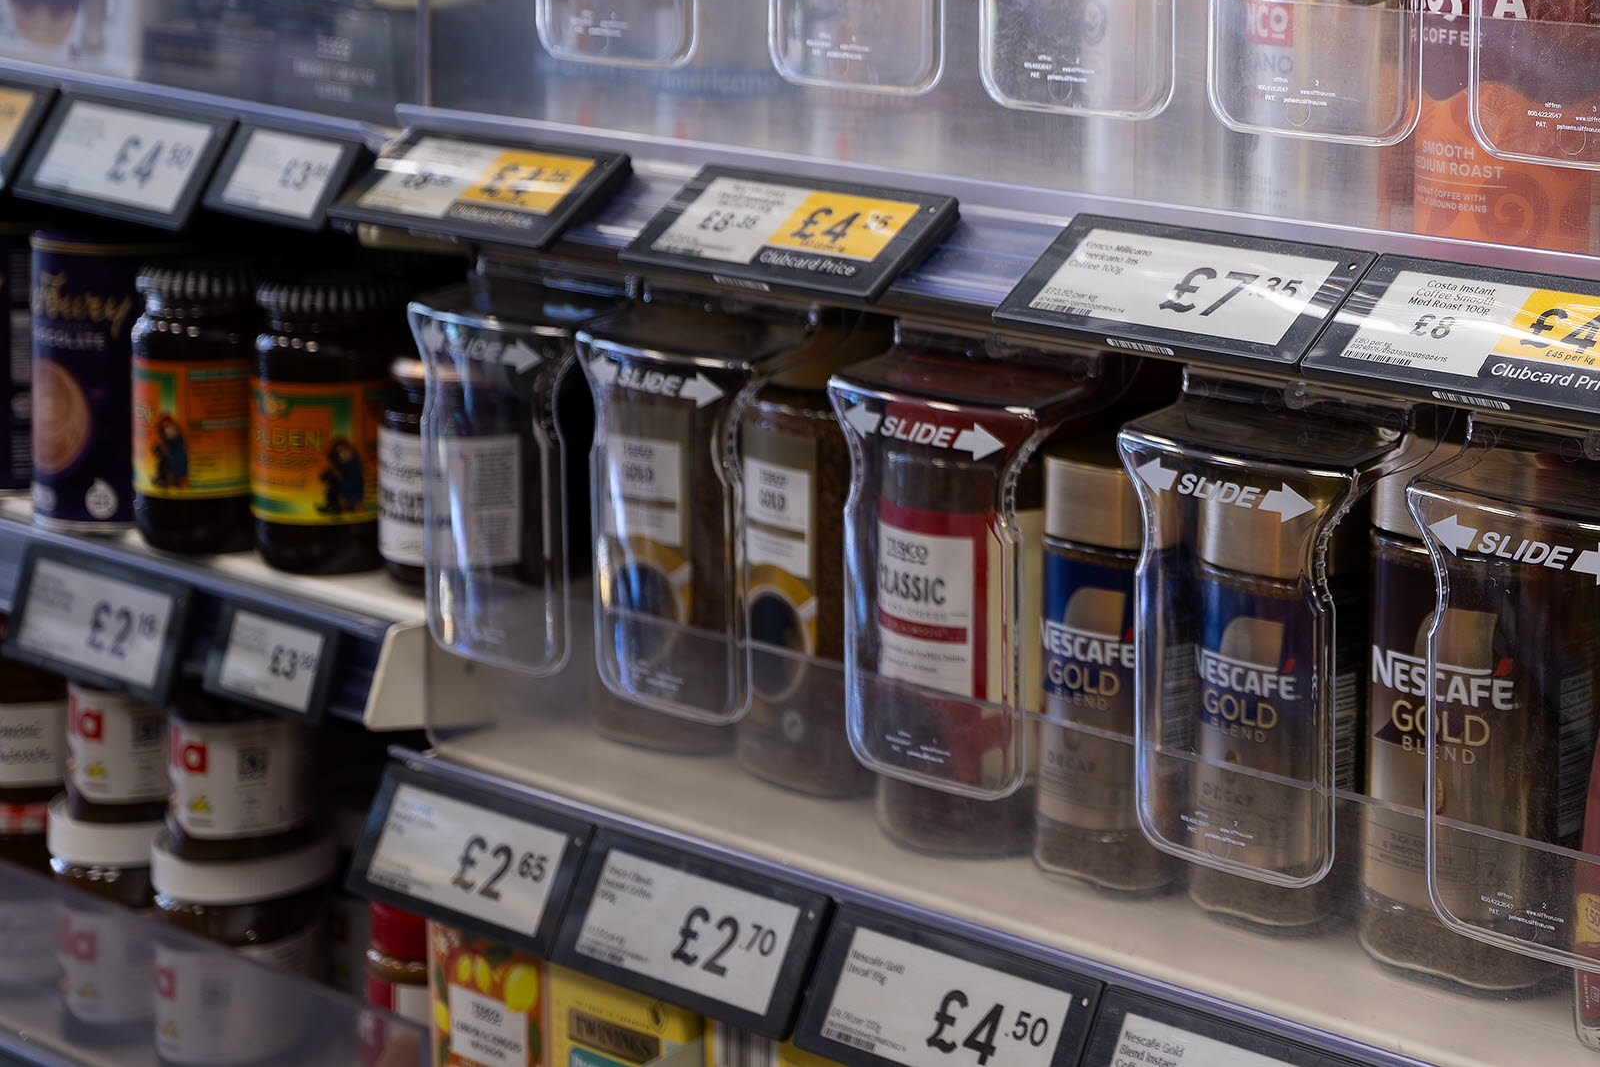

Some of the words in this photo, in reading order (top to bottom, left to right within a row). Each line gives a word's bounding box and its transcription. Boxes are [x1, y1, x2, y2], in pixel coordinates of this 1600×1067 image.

[760, 250, 817, 273] Clubcard
[819, 259, 856, 277] Price
[1086, 240, 1112, 254] Kenco
[1114, 244, 1152, 258] Millicano
[1068, 260, 1099, 273] Coffee
[1101, 264, 1123, 275] 100g
[1159, 266, 1303, 317] £7.35
[1416, 287, 1455, 300] Coffee
[1456, 292, 1495, 306] Smooth
[1427, 279, 1459, 292] Costa
[1460, 283, 1496, 296] Instant
[1407, 296, 1430, 308] Med
[1432, 299, 1463, 311] Roast
[1465, 304, 1491, 317] 100g
[1409, 313, 1456, 339] £8
[1545, 350, 1561, 359] £45
[1562, 353, 1582, 363] per
[1584, 356, 1595, 365] kg
[617, 367, 683, 396] SLIDE
[1491, 362, 1573, 388] Clubcard
[881, 415, 956, 448] SLIDE
[1177, 473, 1261, 509] SLIDE
[1476, 531, 1574, 571] SLIDE
[879, 563, 946, 606] CLASSIC
[1047, 655, 1121, 697] GOLD
[1203, 688, 1278, 730] GOLD
[1391, 699, 1490, 748] GOLD
[1210, 713, 1266, 743] BLEND
[450, 834, 549, 903] £2.65
[671, 904, 777, 979] £2.70
[926, 989, 1049, 1066] £4.50
[1119, 1045, 1145, 1065] Blend
[1145, 1052, 1179, 1067] Instant
[1124, 1029, 1160, 1053] Nescafe
[1162, 1040, 1185, 1060] Gold
